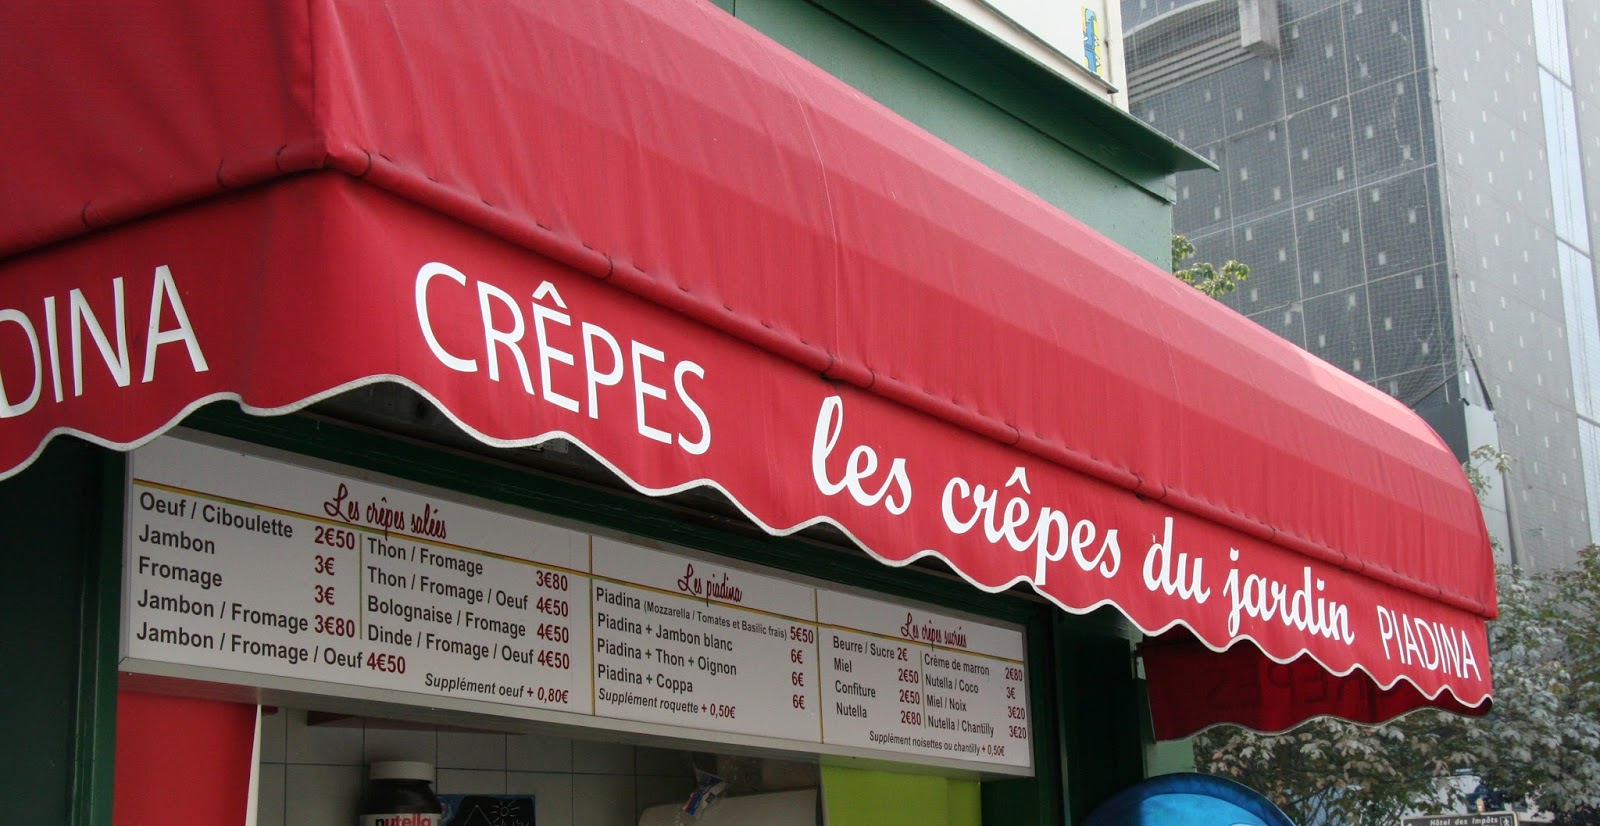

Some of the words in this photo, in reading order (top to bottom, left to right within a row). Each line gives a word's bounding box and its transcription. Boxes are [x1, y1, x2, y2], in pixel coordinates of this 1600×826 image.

[415, 261, 712, 455] CRÊPES
[140, 491, 187, 517] Oeuf
[203, 504, 293, 538] Ciboulette
[315, 525, 355, 550] 2€50
[324, 483, 360, 523] Les
[366, 497, 404, 541] crêpes
[411, 504, 446, 539] salées
[811, 395, 912, 515] les
[942, 467, 1121, 586] crêpes
[1143, 517, 1210, 599] du
[1223, 548, 1355, 646] jardin
[139, 524, 215, 554] Jambon
[314, 555, 335, 576] 3€
[368, 537, 406, 560] Thon
[420, 548, 483, 577] Fromage
[536, 570, 568, 591] 3€80
[139, 556, 223, 590] Fromage
[314, 585, 335, 605] 3€
[368, 566, 406, 589] Thon
[420, 577, 483, 604] Fromage
[496, 591, 528, 610] Oeuf
[537, 597, 568, 617] 4€50
[678, 563, 702, 595] Les
[706, 573, 743, 607] piadina
[137, 589, 214, 618] Jambon
[232, 603, 309, 634] Fromage
[314, 615, 355, 638] 3€80
[368, 595, 452, 625] Bolognaise
[466, 612, 526, 639] Fromage
[537, 623, 569, 644] 4€50
[596, 587, 641, 610] Piadina
[697, 611, 731, 627] Tomates
[732, 620, 740, 629] et
[742, 621, 767, 634] Basilic
[768, 626, 787, 641] frais)
[790, 626, 814, 644] 5€50
[901, 613, 919, 641] Les
[137, 622, 214, 649] Jambon
[232, 635, 309, 665] Fromage
[324, 648, 363, 668] Oeuf
[367, 652, 406, 674] 4€50
[368, 624, 412, 647] Dinde
[426, 633, 489, 661] Fromage
[502, 645, 534, 664] Oeuf
[537, 650, 570, 670] 4€50
[597, 613, 642, 635] Piadina
[656, 625, 701, 645] Jambon
[704, 632, 733, 652] blanc
[1378, 605, 1482, 681] PIADINA
[597, 638, 642, 659] Piadina
[656, 649, 684, 667] Thon
[698, 656, 737, 676] Oignon
[791, 649, 803, 664] 6€
[833, 636, 863, 654] Beurre
[870, 644, 895, 659] Sucre
[897, 648, 908, 662] 2€
[598, 664, 642, 685] Piadina
[656, 674, 693, 694] Coppa
[792, 672, 804, 687] 6€
[834, 658, 852, 673] Miel
[898, 668, 919, 684] 2€50
[924, 654, 950, 669] Crème
[952, 659, 961, 671] de
[963, 663, 990, 676] marron
[1005, 667, 1023, 682] 2€80
[425, 673, 496, 695] Supplément
[499, 685, 524, 697] oeuf
[537, 687, 568, 704] 0,80€
[835, 680, 876, 698] Confiture
[899, 690, 920, 705] 2€50
[925, 675, 953, 690] Nutella
[959, 680, 979, 694] Coco
[1006, 686, 1015, 700] 3€
[598, 688, 658, 708] Supplément
[660, 700, 699, 714] roquette
[710, 704, 736, 719] 0,50€
[792, 695, 805, 710] 6€
[836, 702, 868, 718] Nutella
[901, 711, 921, 726] 2€80
[927, 695, 943, 708] Miel
[949, 699, 967, 712] Noix
[1008, 706, 1025, 720] 3€20
[869, 731, 911, 746] Supplément
[912, 737, 942, 749] noisettes
[944, 742, 952, 750] ou
[954, 742, 980, 756] chantilly
[987, 745, 1005, 756] 0,50€
[928, 716, 956, 731] Nutella
[962, 722, 994, 738] Chantilly
[1009, 726, 1027, 740] 3€20
[1472, 817, 1498, 825] Impôts
